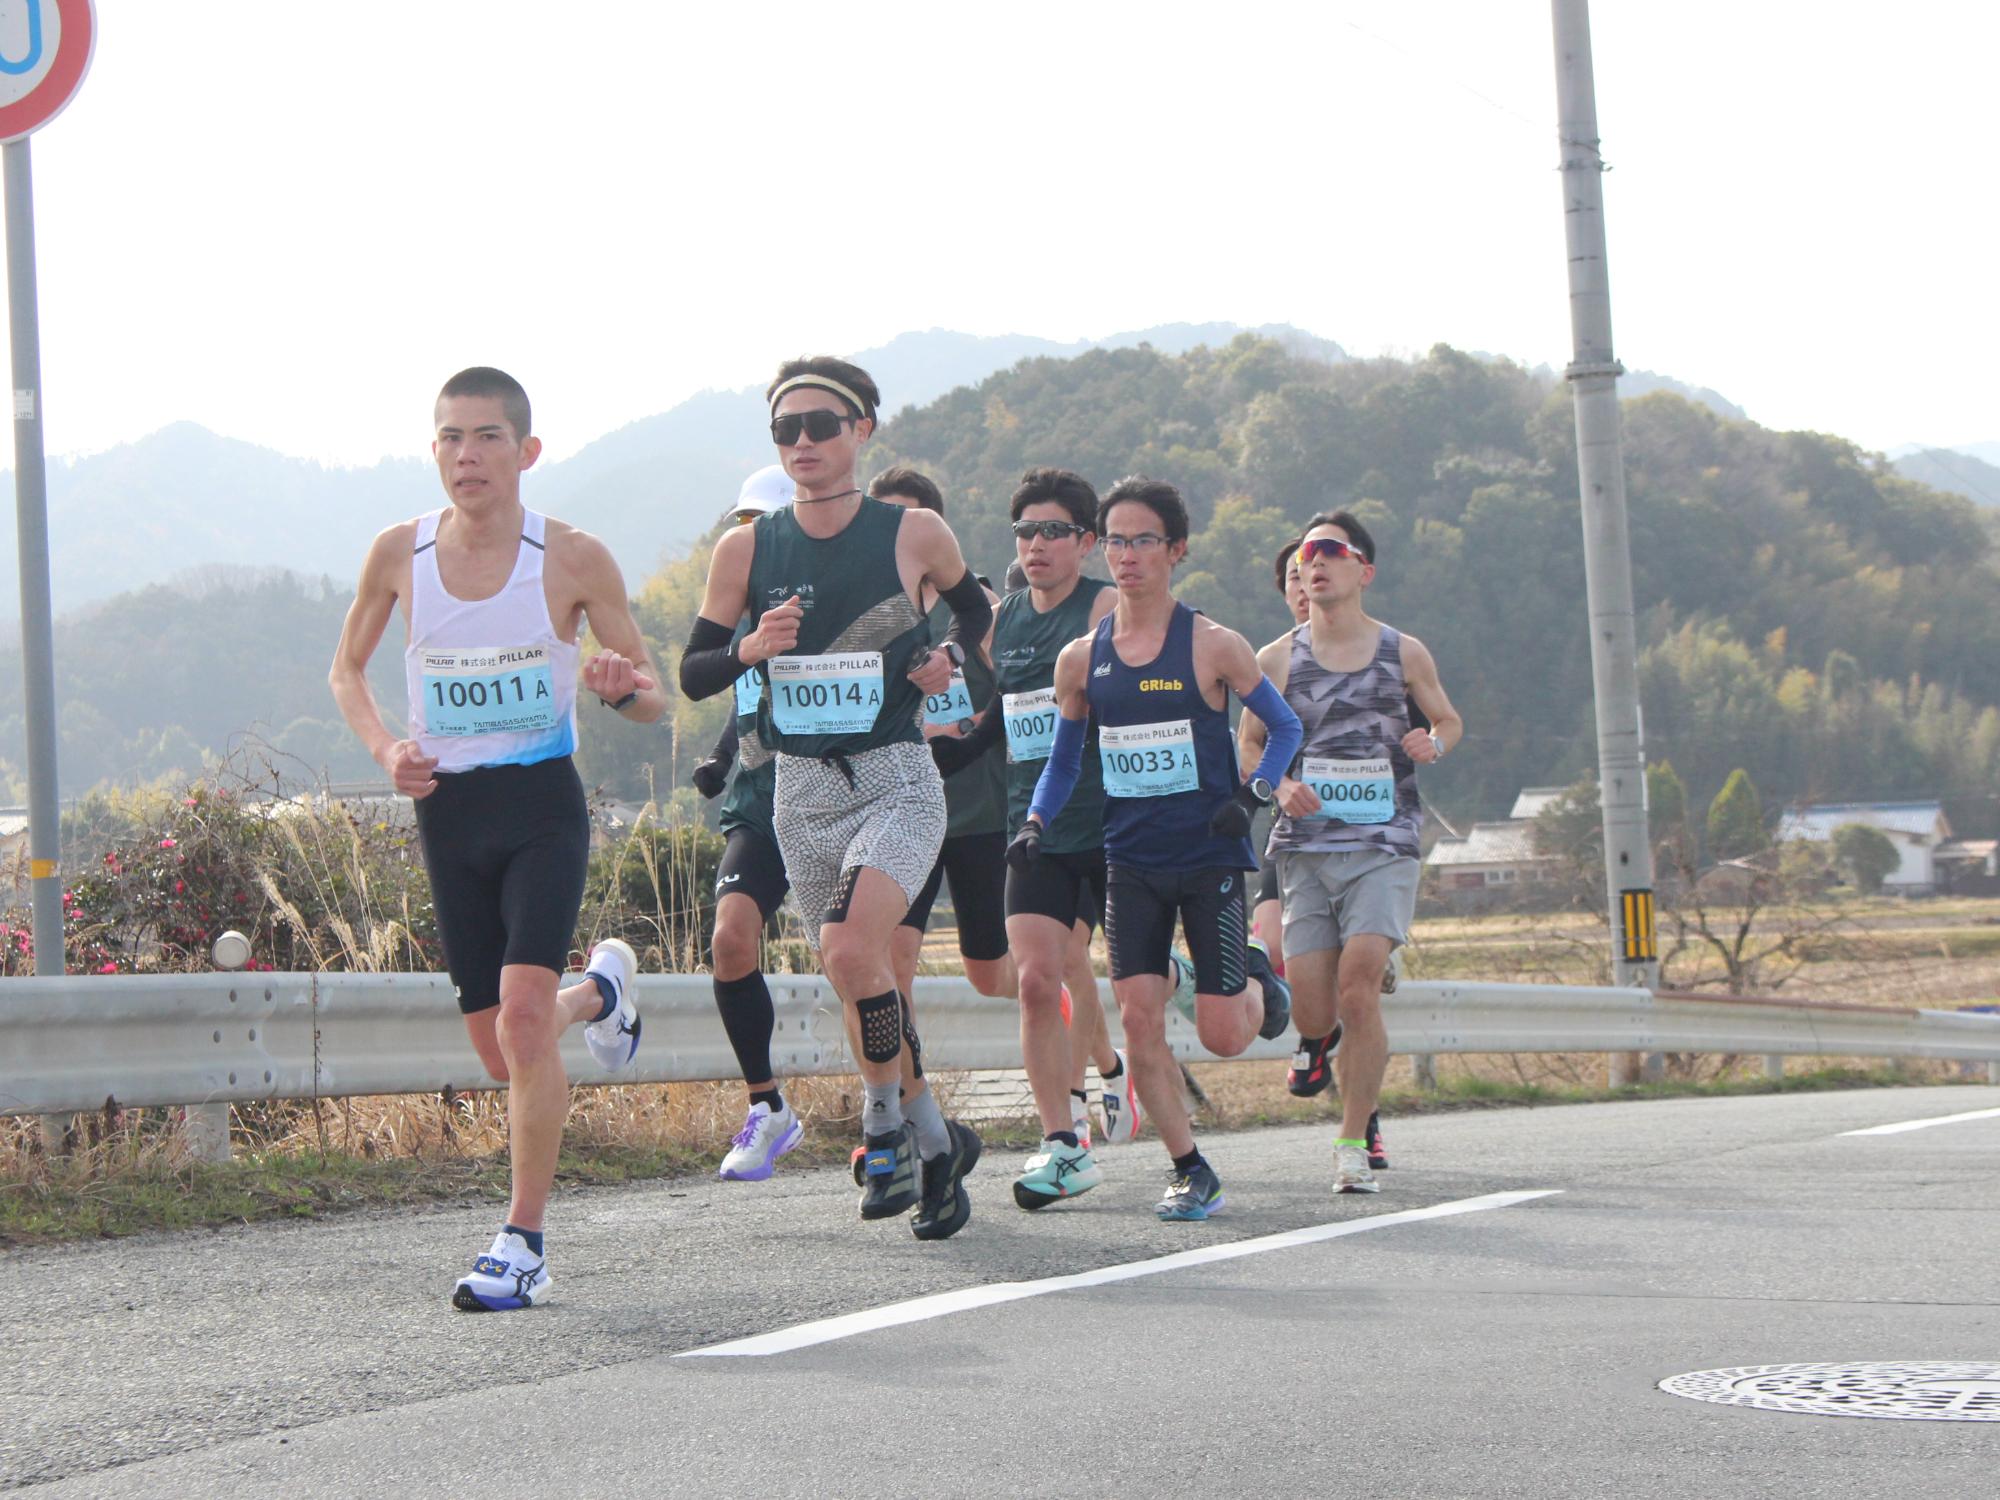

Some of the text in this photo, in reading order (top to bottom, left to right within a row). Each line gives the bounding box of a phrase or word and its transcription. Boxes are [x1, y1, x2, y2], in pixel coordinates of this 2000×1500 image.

[461, 650, 544, 667] 株式会社 PILLAR
[839, 660, 879, 670] PILLAR
[432, 676, 549, 707] 10011 A
[1139, 679, 1183, 692] GRlab
[782, 682, 880, 708] 10014 A
[958, 694, 968, 708] A
[1153, 727, 1188, 739] PILLAR
[1107, 750, 1193, 774] 10033 A
[1360, 764, 1389, 774] PILLAR
[1380, 788, 1389, 801] A
